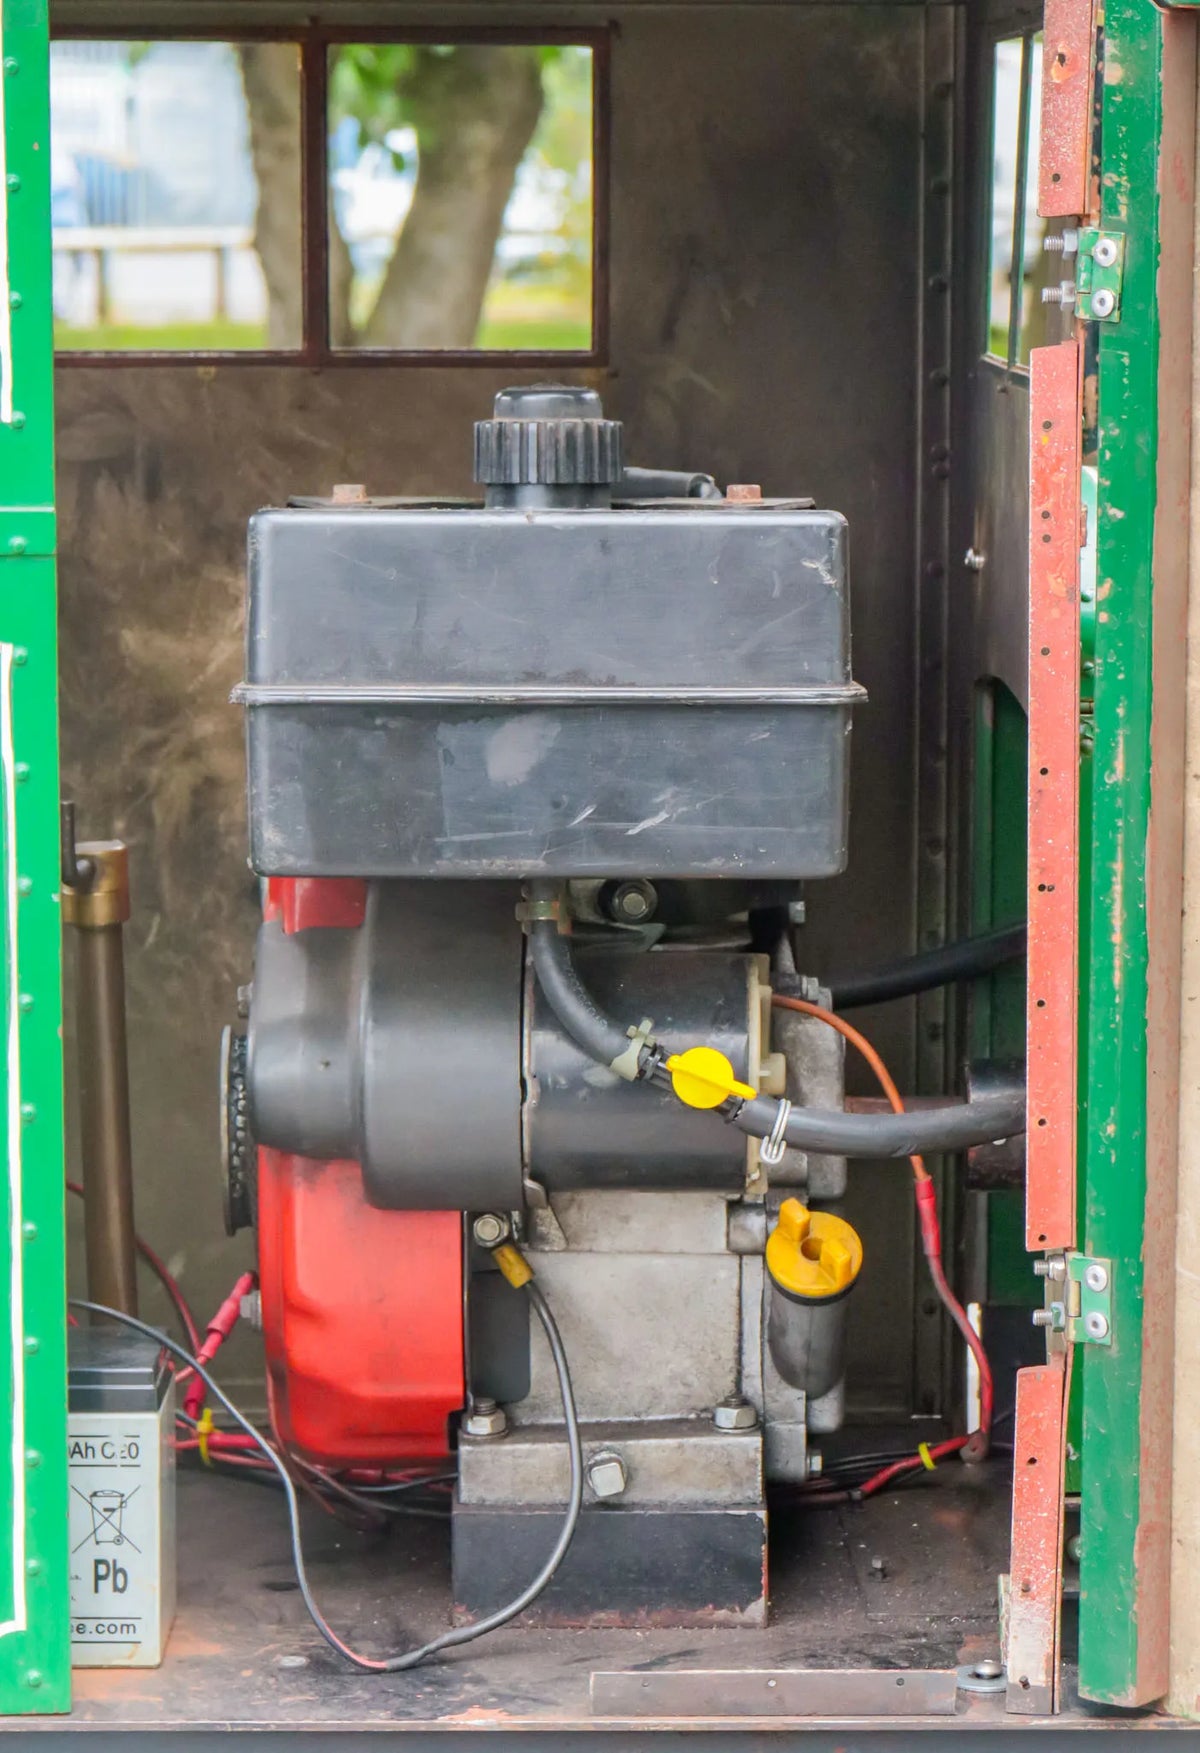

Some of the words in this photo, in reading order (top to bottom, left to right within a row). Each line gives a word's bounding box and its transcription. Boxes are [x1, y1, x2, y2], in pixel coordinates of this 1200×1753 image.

[68, 1441, 95, 1459] Ah
[93, 1558, 128, 1594] Pb
[70, 1622, 137, 1635] e.com
